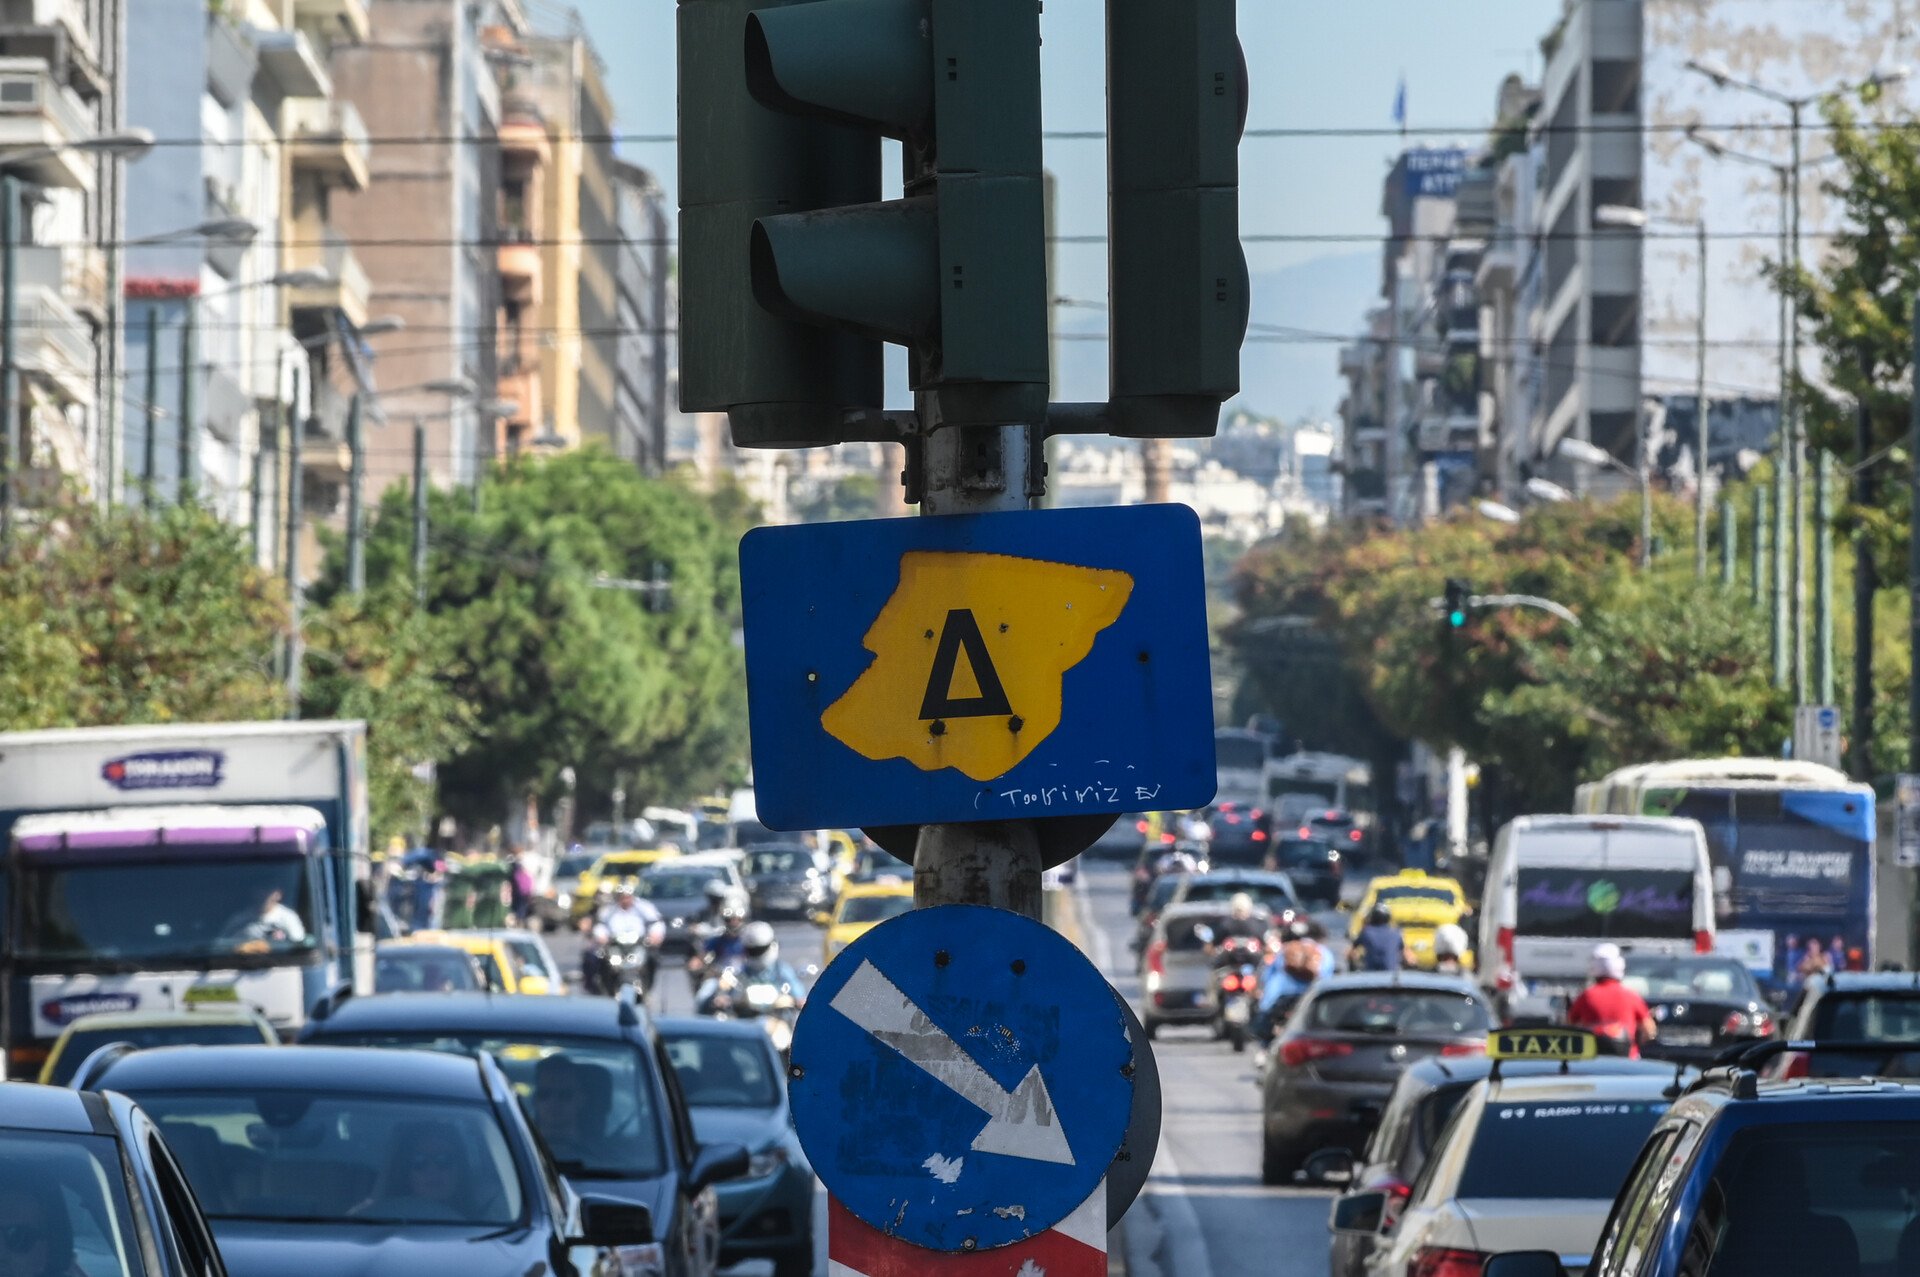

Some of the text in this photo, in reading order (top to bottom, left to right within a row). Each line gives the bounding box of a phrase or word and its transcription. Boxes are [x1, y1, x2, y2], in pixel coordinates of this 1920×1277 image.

[918, 608, 1013, 720] Δ
[1508, 1036, 1573, 1055] TAXI
[1535, 1106, 1582, 1118] RADIO
[1585, 1104, 1617, 1115] TAXI
